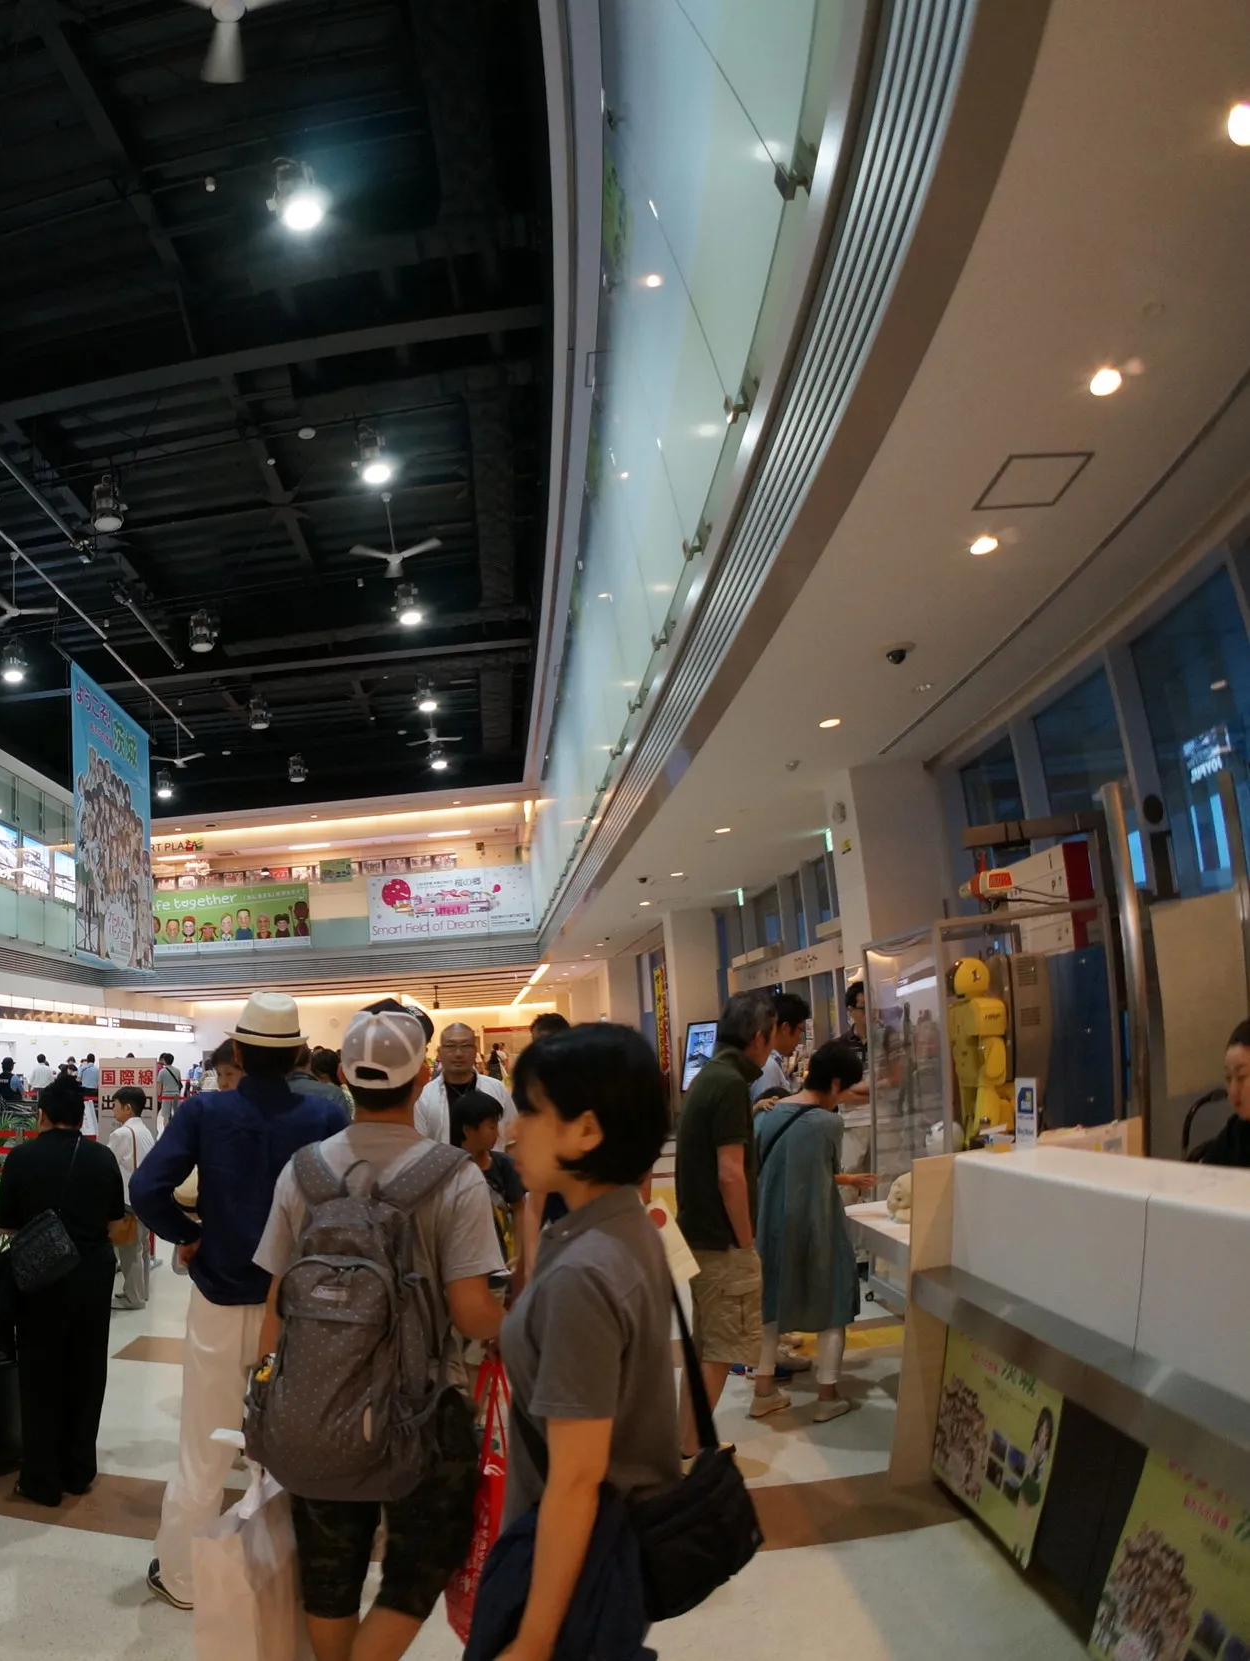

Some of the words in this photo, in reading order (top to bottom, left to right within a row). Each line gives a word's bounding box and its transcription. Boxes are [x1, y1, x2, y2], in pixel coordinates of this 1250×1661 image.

[173, 893, 238, 910] together
[372, 923, 403, 936] Smart
[405, 921, 430, 934] Field
[432, 921, 444, 932] of
[446, 917, 488, 931] Dreams
[101, 1069, 154, 1085] 国際線
[101, 1095, 153, 1111] 出口
